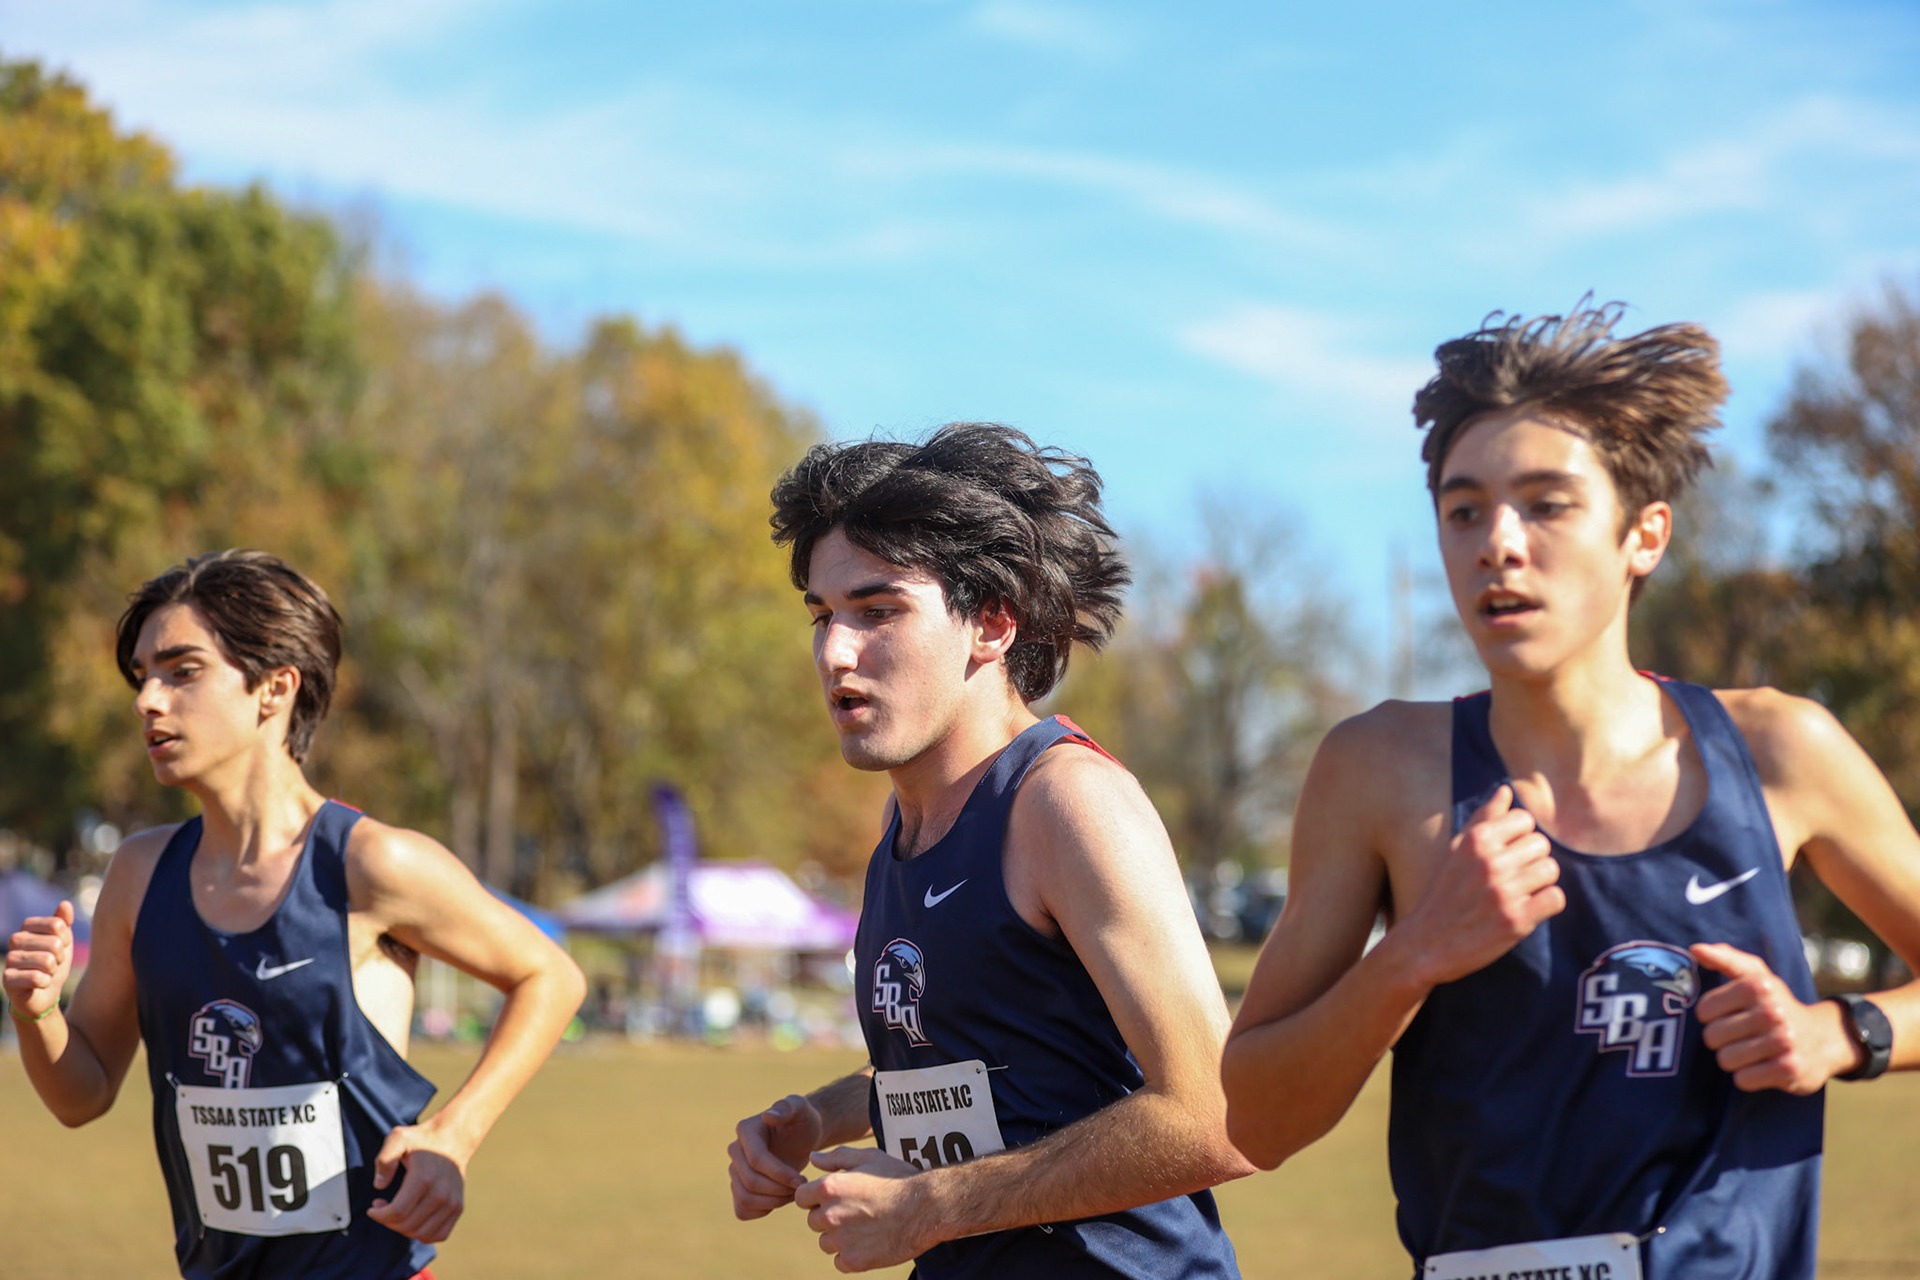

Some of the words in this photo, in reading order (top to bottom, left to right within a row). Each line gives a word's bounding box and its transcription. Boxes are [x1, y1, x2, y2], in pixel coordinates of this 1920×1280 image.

[875, 964, 927, 1043] SBA
[1582, 972, 1678, 1070] SBA
[193, 1017, 247, 1088] SBA
[191, 1105, 236, 1126] TSSAA
[240, 1106, 287, 1126] STATE
[291, 1104, 316, 1124] XC
[886, 1092, 914, 1116] TSSAA
[914, 1088, 951, 1114] STATE
[950, 1084, 973, 1109] XC
[208, 1145, 308, 1211] 519
